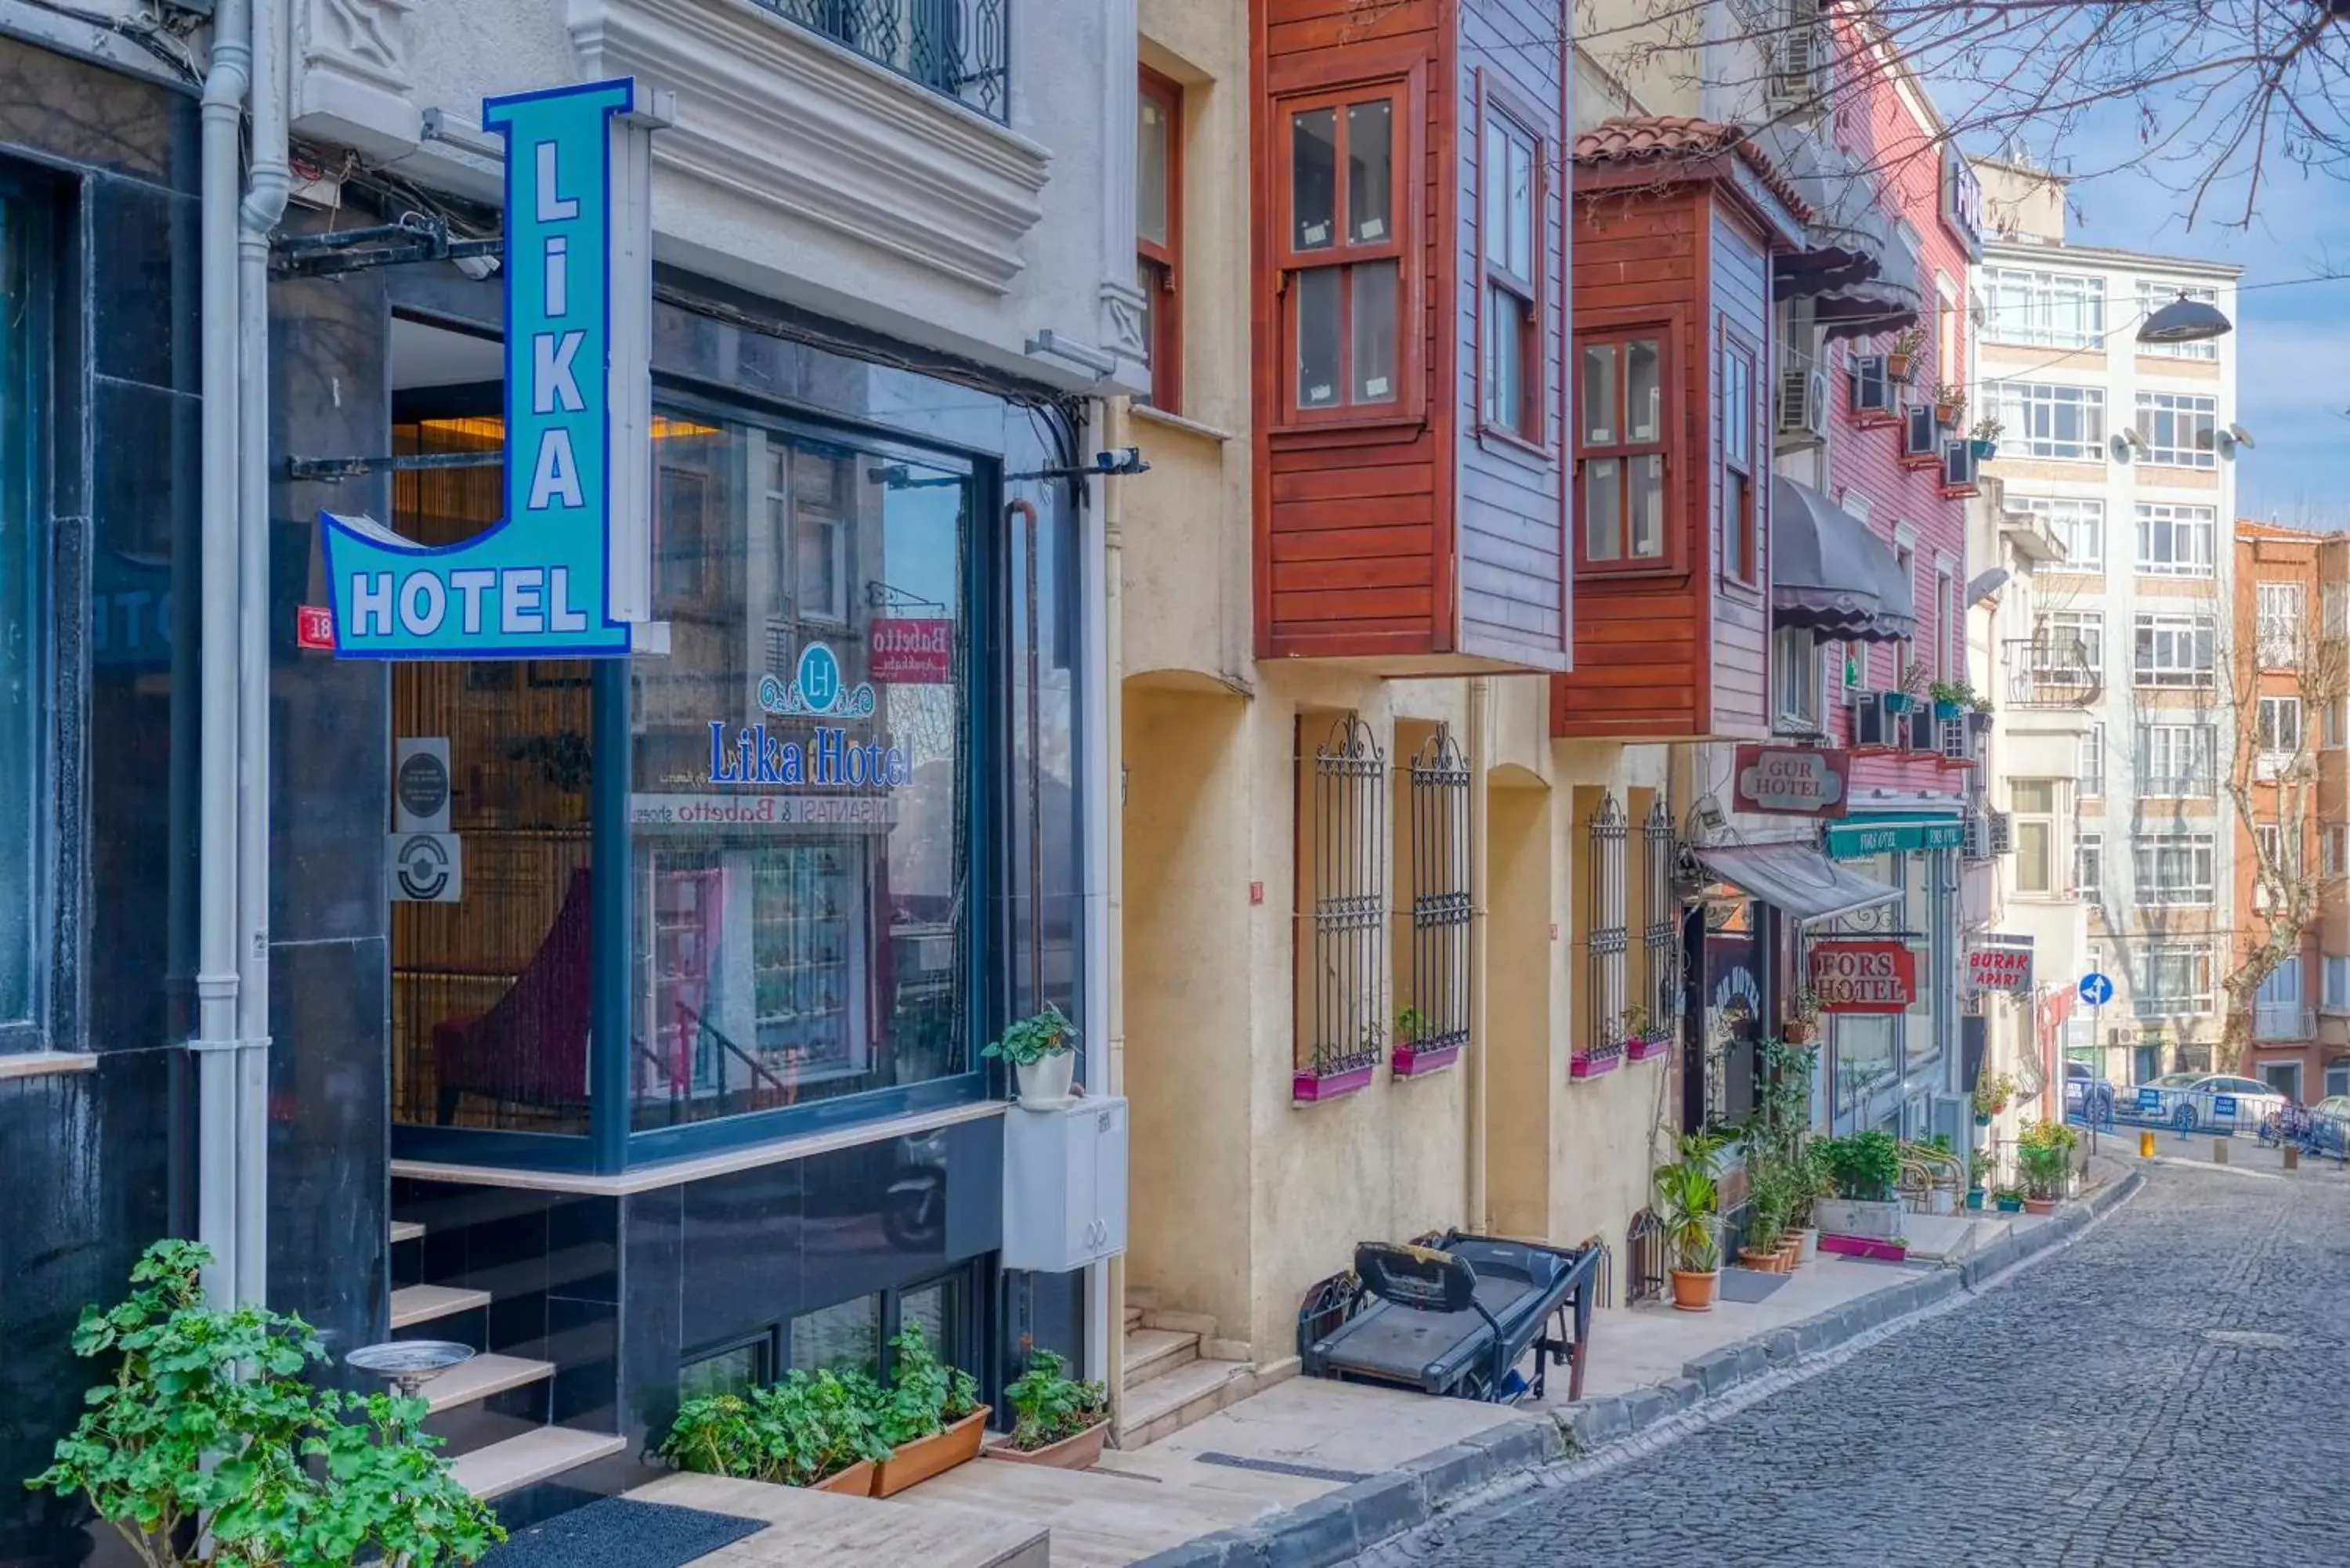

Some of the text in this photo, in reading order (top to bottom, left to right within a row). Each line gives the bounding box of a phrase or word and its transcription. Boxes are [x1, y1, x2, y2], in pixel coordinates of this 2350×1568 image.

[351, 565, 587, 637] HOTEL
[311, 616, 332, 638] 18
[708, 720, 804, 785] Lika
[814, 727, 913, 787] Hotel
[1754, 779, 1826, 797] HOTEL
[1820, 953, 1893, 977] FORS
[1970, 952, 2028, 971] BURAK
[1817, 978, 1906, 1000] HOTEL
[1976, 972, 2021, 987] APART
